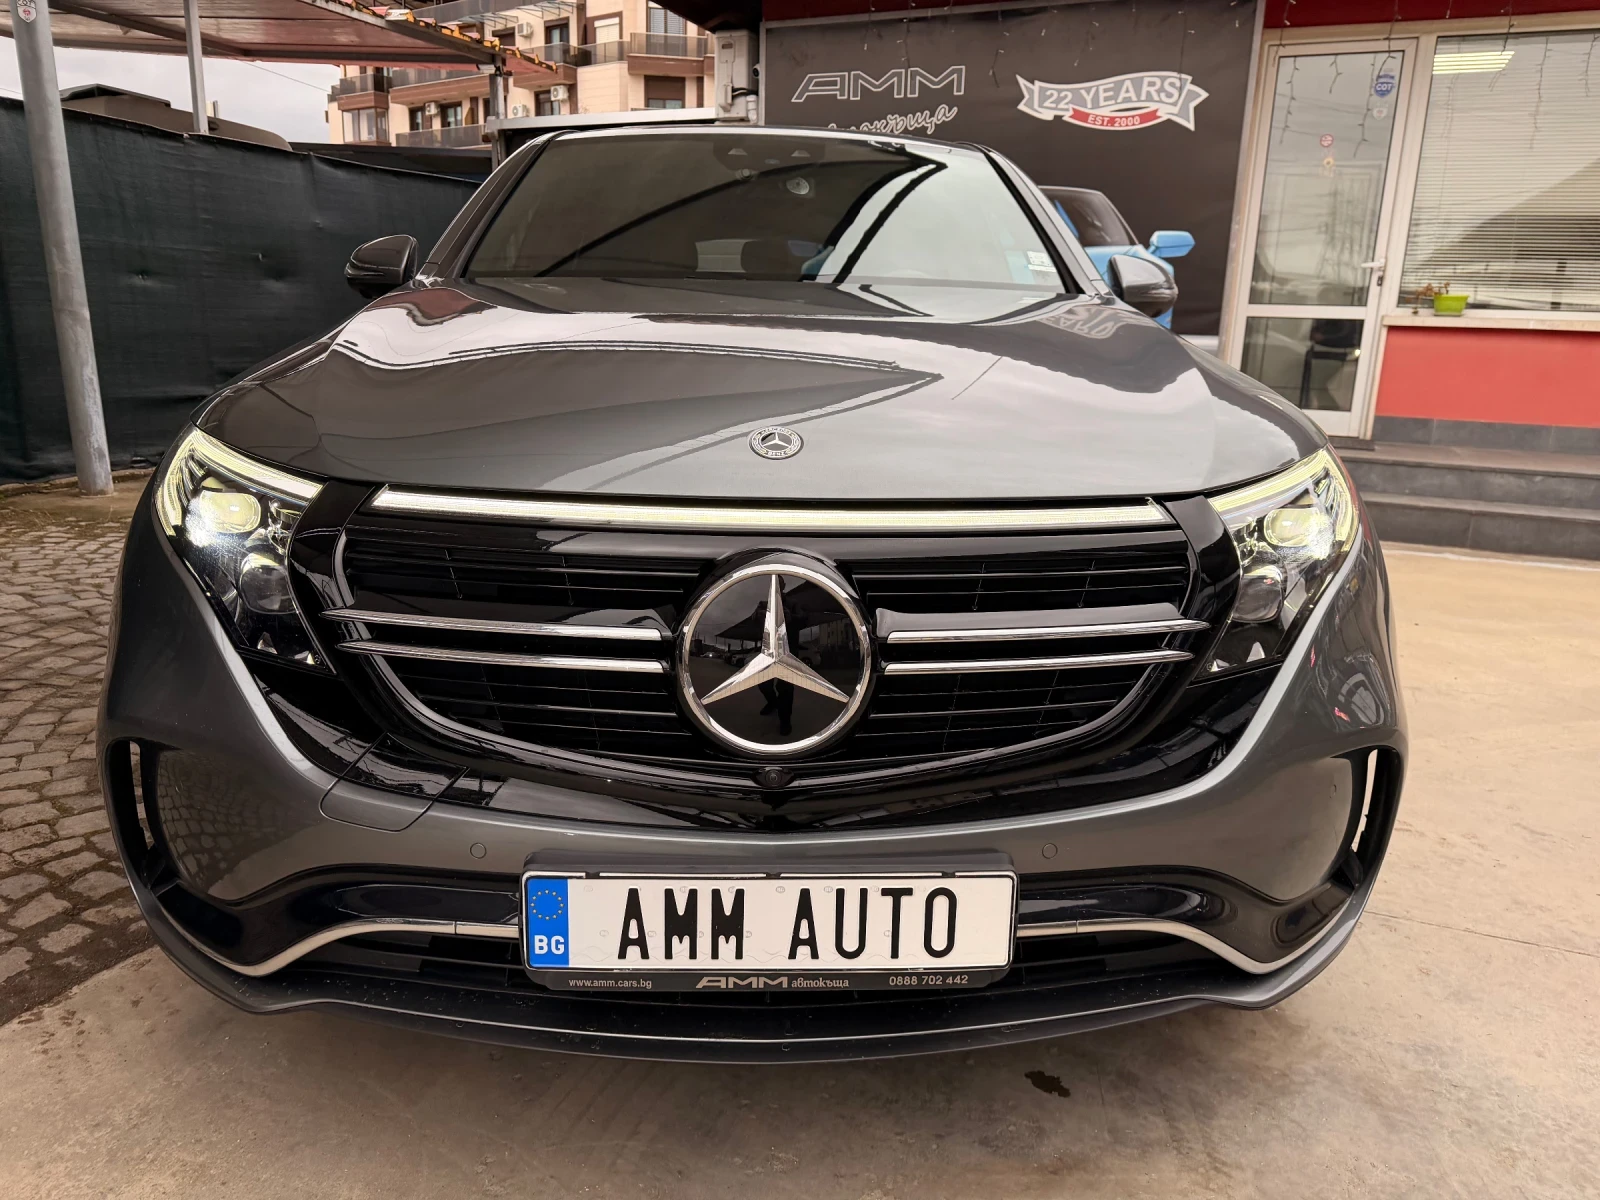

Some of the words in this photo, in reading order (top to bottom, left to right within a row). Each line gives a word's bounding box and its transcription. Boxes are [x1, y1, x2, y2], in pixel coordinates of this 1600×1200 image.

[791, 65, 966, 103] AMM
[1043, 90, 1073, 109] 22
[1078, 77, 1182, 109] YEARS
[1087, 114, 1111, 126] EST.
[1114, 115, 1141, 128] 2000
[618, 887, 745, 960] AMM
[788, 886, 958, 960] AUTO
[533, 934, 565, 955] BG
[568, 978, 652, 989] www.amm.cars.bg
[695, 976, 788, 989] AMM
[791, 977, 849, 988] автокъща
[889, 976, 918, 986] 0888
[921, 976, 943, 985] 702
[946, 975, 969, 984] 442
